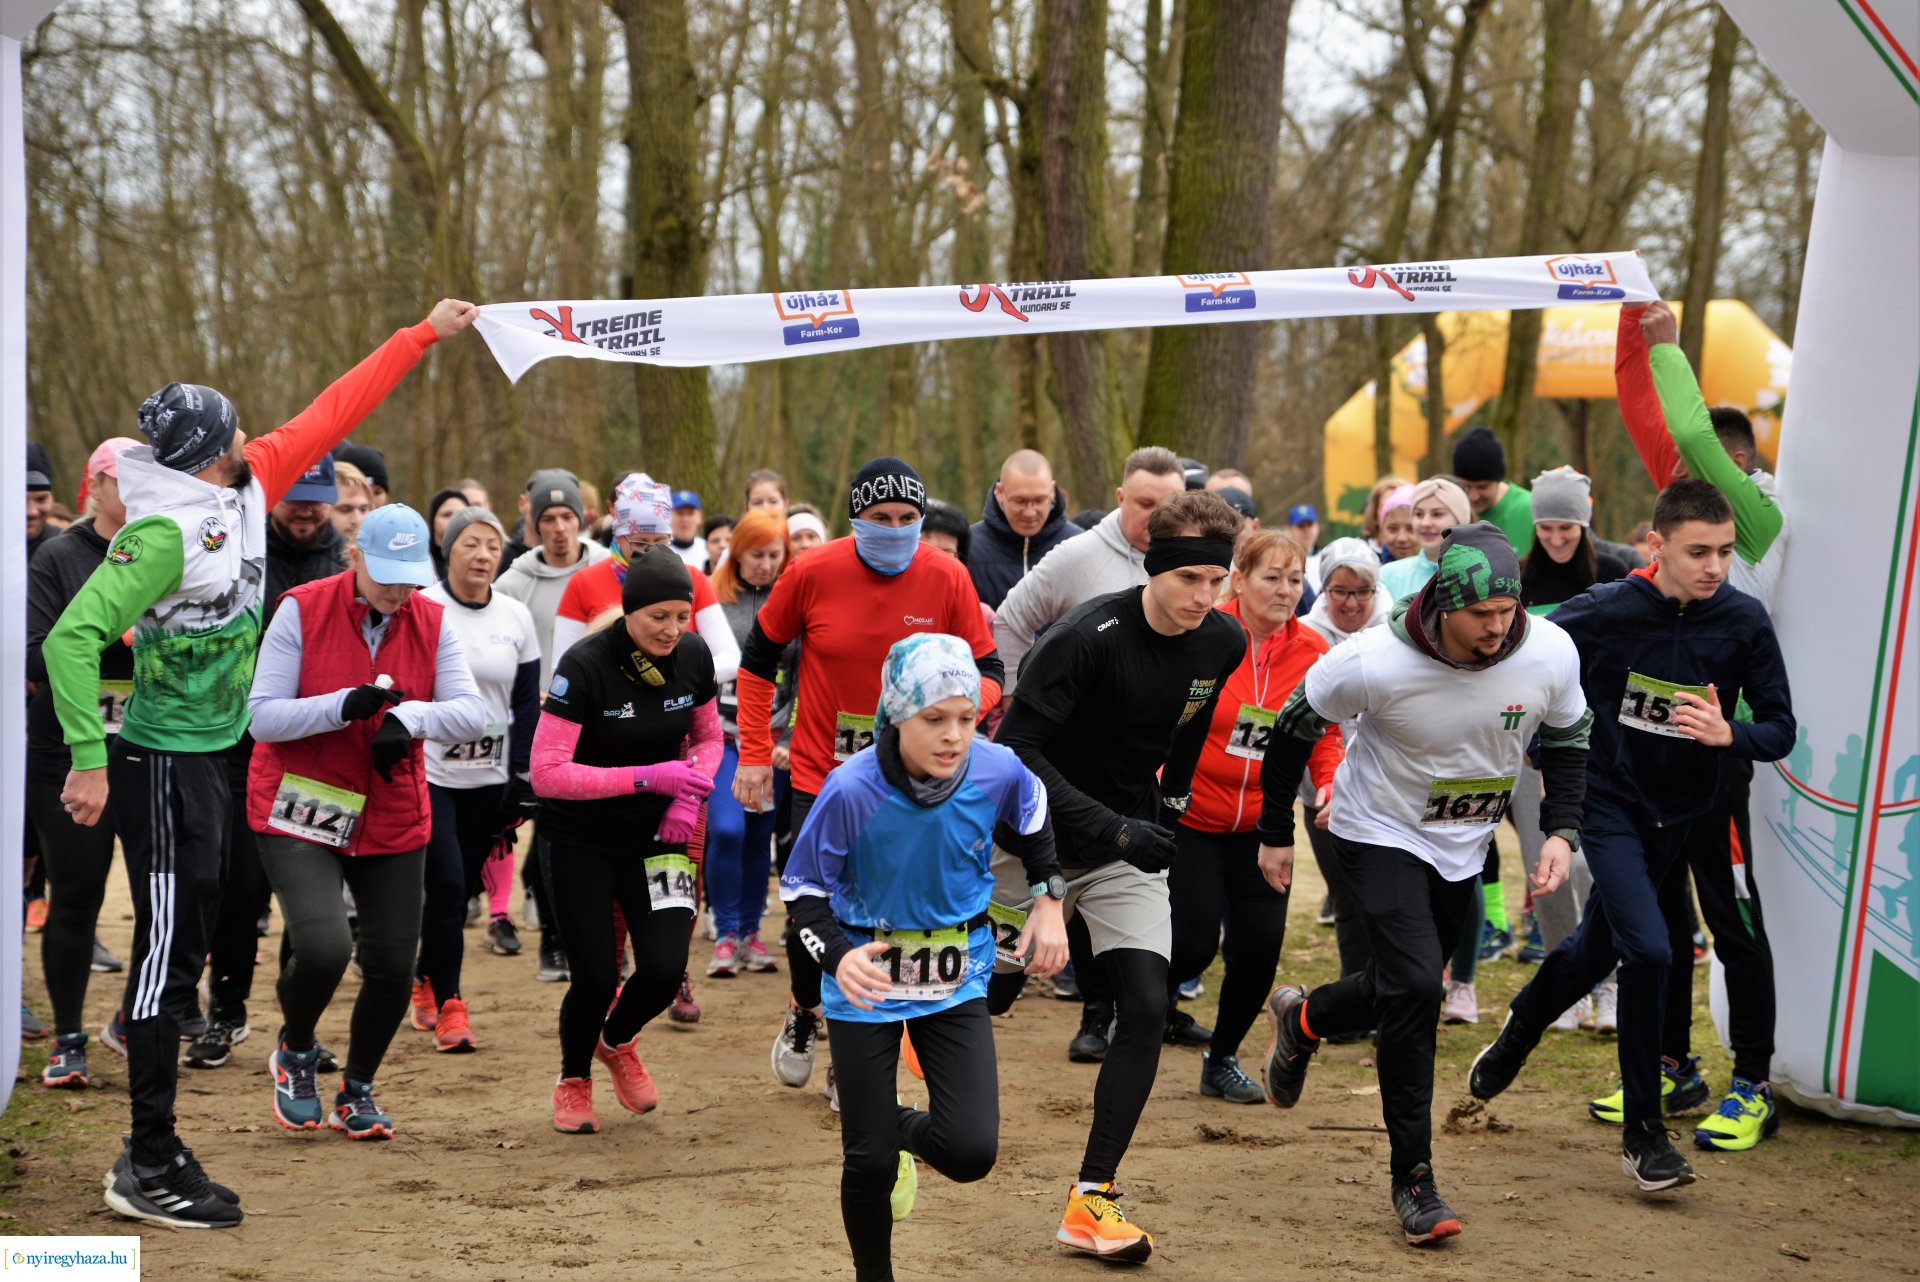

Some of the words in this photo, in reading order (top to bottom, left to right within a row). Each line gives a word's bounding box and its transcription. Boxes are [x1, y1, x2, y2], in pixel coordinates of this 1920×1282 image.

[1395, 272, 1457, 284] TRAIL
[1010, 285, 1077, 302] TRAIL
[1201, 297, 1241, 306] Farm-Ker
[1020, 303, 1058, 313] HUNGARY
[1060, 301, 1071, 311] SE
[593, 327, 666, 350] TRAIL
[800, 326, 843, 338] Farm-Ker
[851, 474, 925, 513] BOGNER
[394, 532, 416, 544] NIKE
[1097, 618, 1115, 631] CRAFT
[444, 735, 494, 759] 219
[280, 792, 342, 833] 112
[1431, 792, 1496, 819] 167
[880, 945, 962, 984] 110
